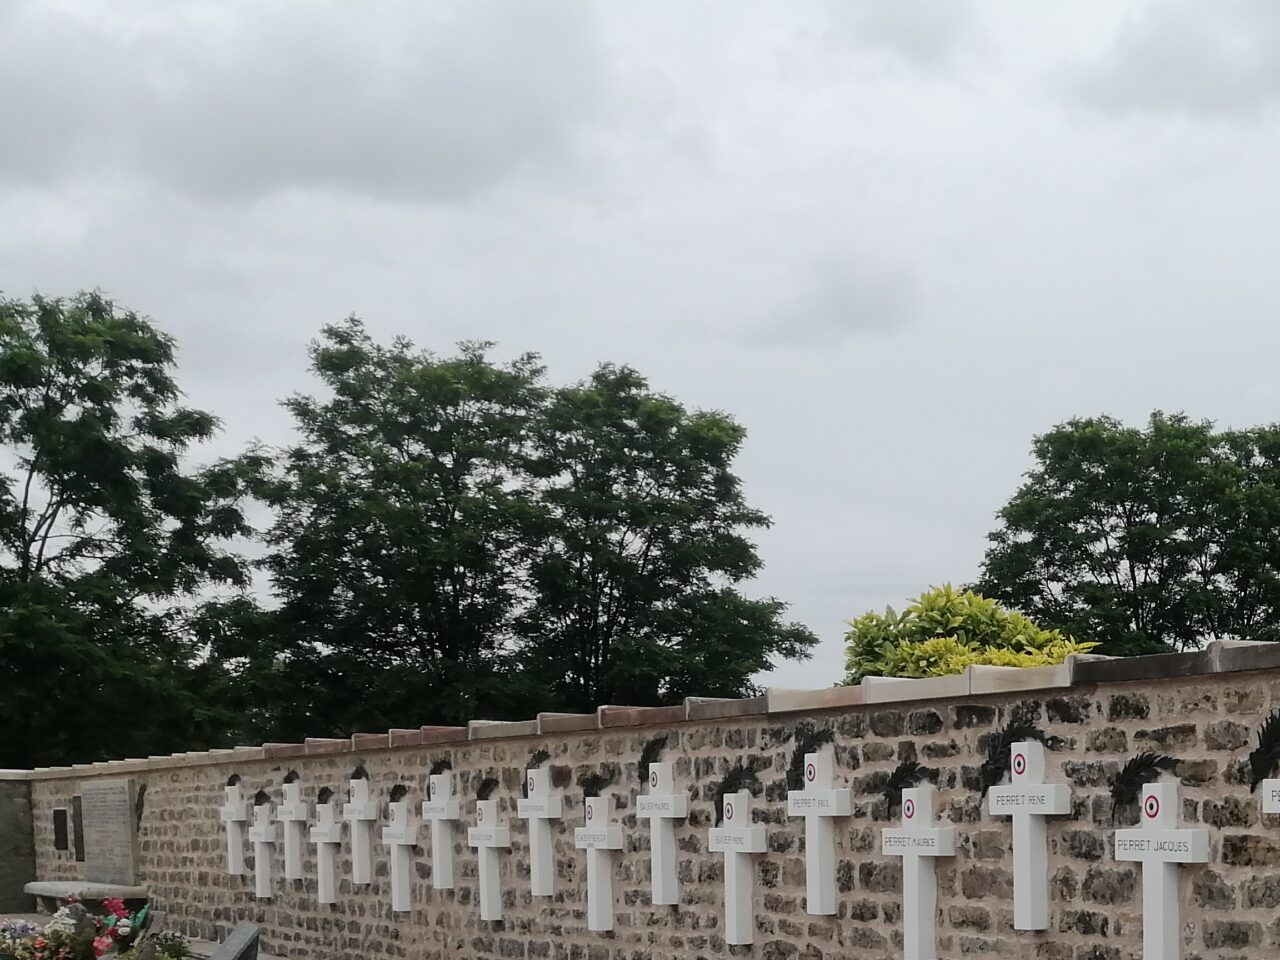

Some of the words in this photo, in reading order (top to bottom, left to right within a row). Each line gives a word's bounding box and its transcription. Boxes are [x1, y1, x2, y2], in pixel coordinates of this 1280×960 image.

[996, 795, 1026, 806] PERRET
[1117, 839, 1151, 851] PERRET
[1153, 841, 1189, 852] JACQUES
